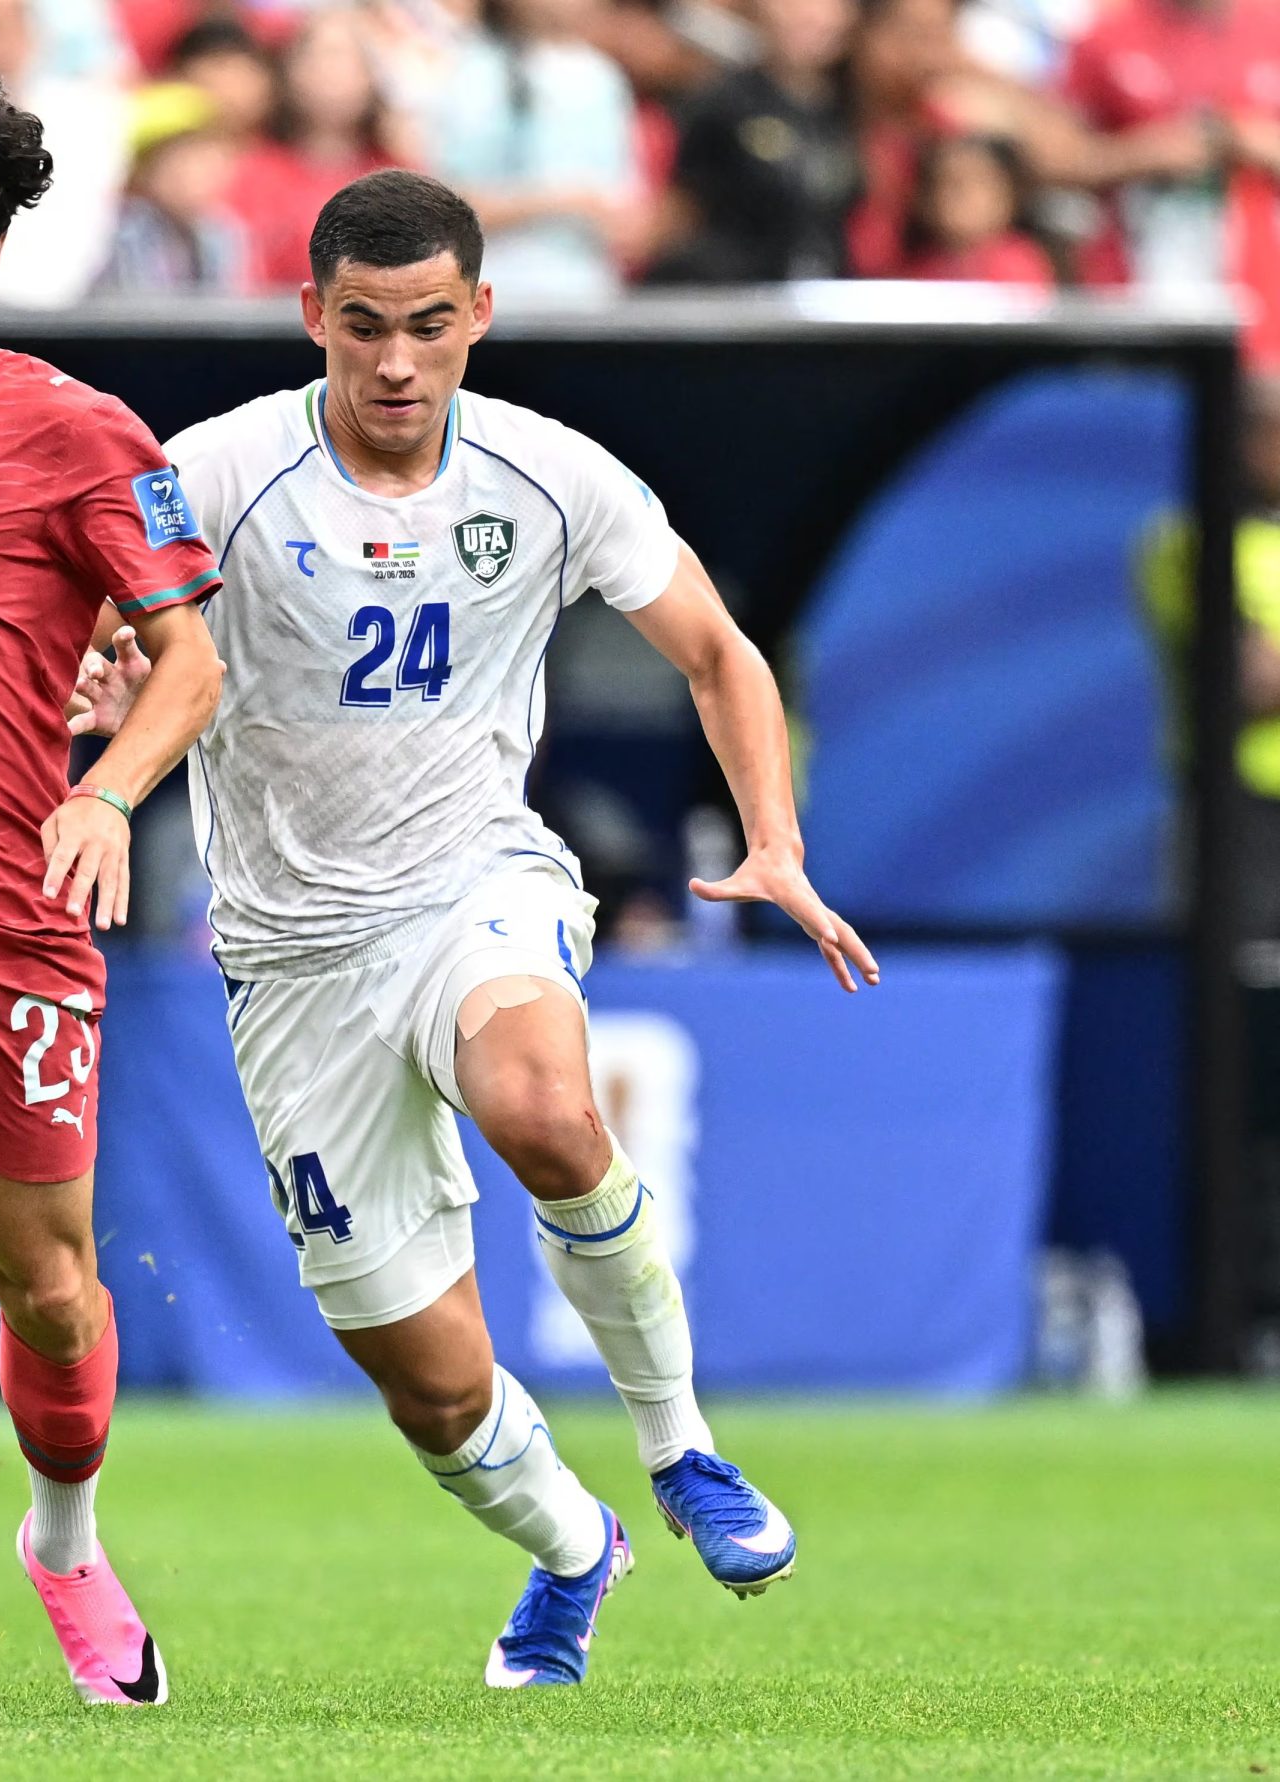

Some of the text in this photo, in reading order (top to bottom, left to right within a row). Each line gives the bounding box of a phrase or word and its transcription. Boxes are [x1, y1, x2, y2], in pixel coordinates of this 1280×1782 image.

[155, 512, 187, 529] PEACE
[164, 526, 181, 535] FIFA
[463, 526, 508, 552] UFA
[374, 570, 416, 579] 23/06/2026
[339, 602, 453, 708] 24
